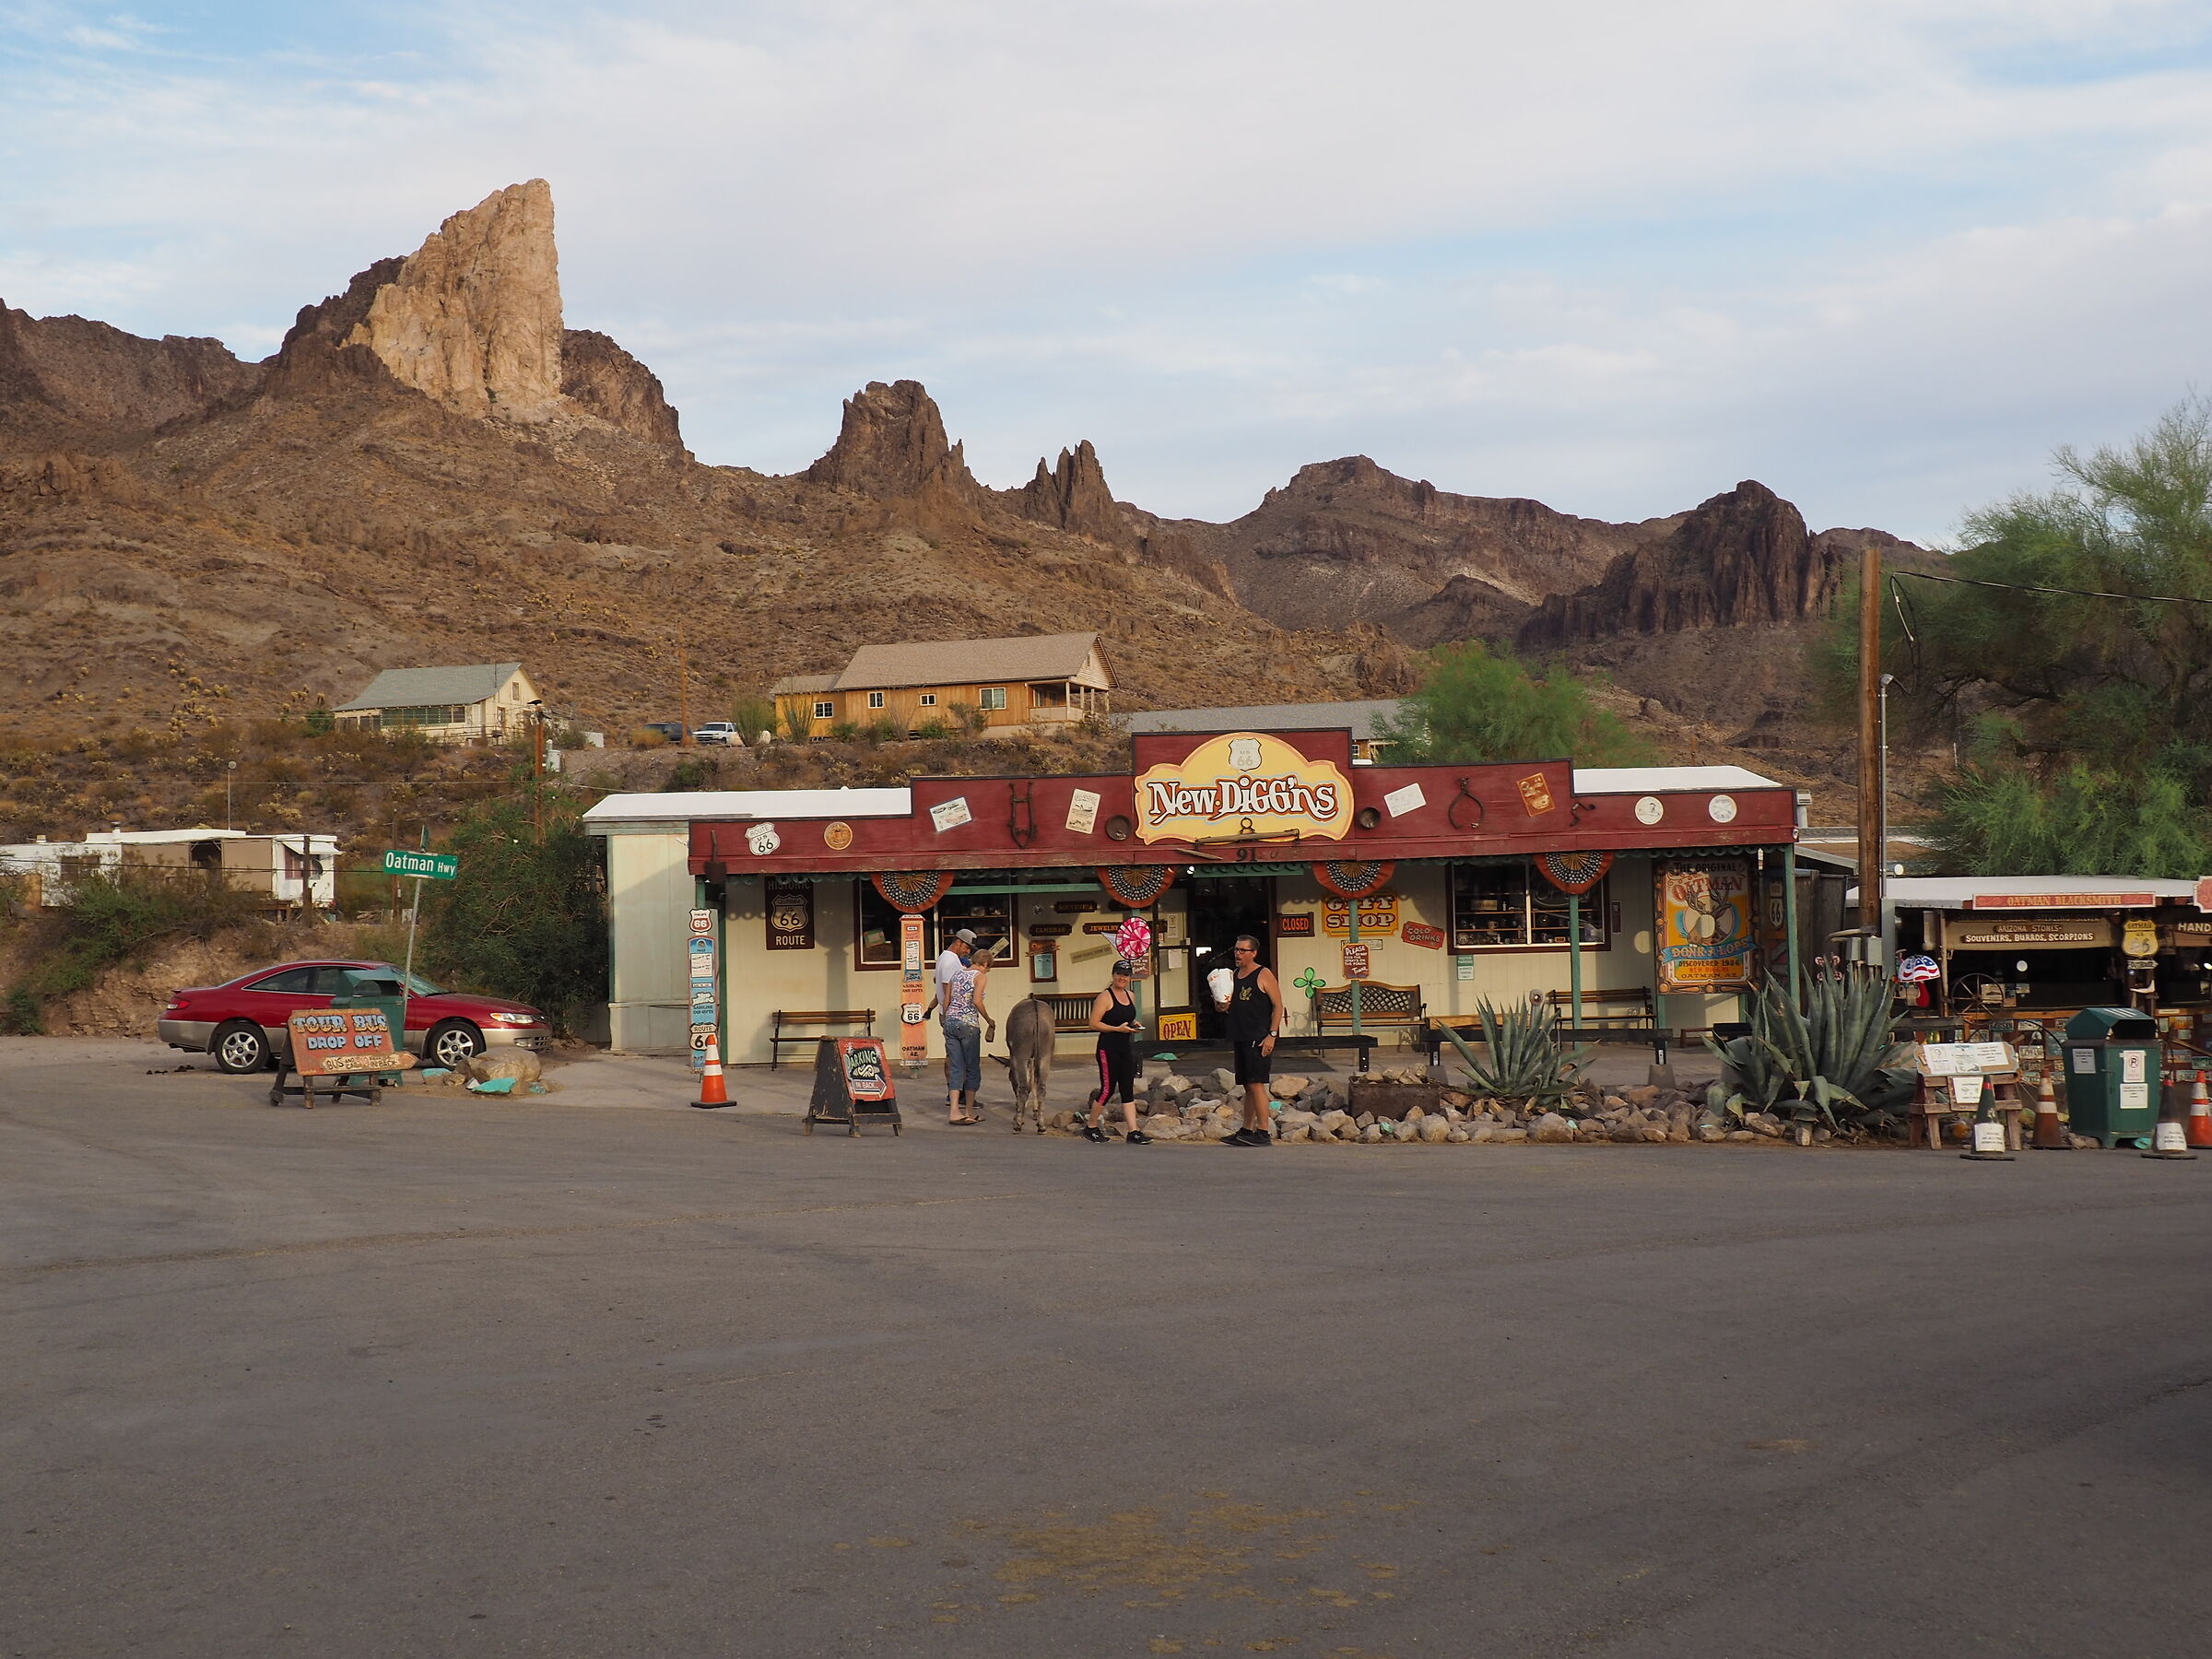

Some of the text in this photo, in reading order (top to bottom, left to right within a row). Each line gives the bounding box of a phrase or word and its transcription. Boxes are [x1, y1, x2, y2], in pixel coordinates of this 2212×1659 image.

[1237, 756, 1253, 767] 66
[749, 825, 770, 837] ROUTE
[758, 839, 774, 853] 66
[1236, 848, 1257, 862] 91
[385, 852, 455, 877] Oatman Hwy
[1696, 863, 1736, 873] ORIGINAL
[2006, 895, 2121, 906] OATMAN BLACKSMITH
[694, 919, 708, 929] 66
[780, 913, 800, 926] 66
[1282, 917, 1309, 931] CLOSED
[775, 935, 806, 947] ROUTE
[1410, 935, 1441, 943] DRINKS
[2048, 933, 2094, 941] SCORPIONS
[1346, 946, 1366, 956] PLEASE
[292, 1014, 388, 1033] TOUR BUS
[1162, 1019, 1193, 1040] OPEN
[307, 1034, 383, 1050] DROP OFF
[325, 1057, 345, 1070] BUS
[842, 1050, 877, 1079] PARKING
